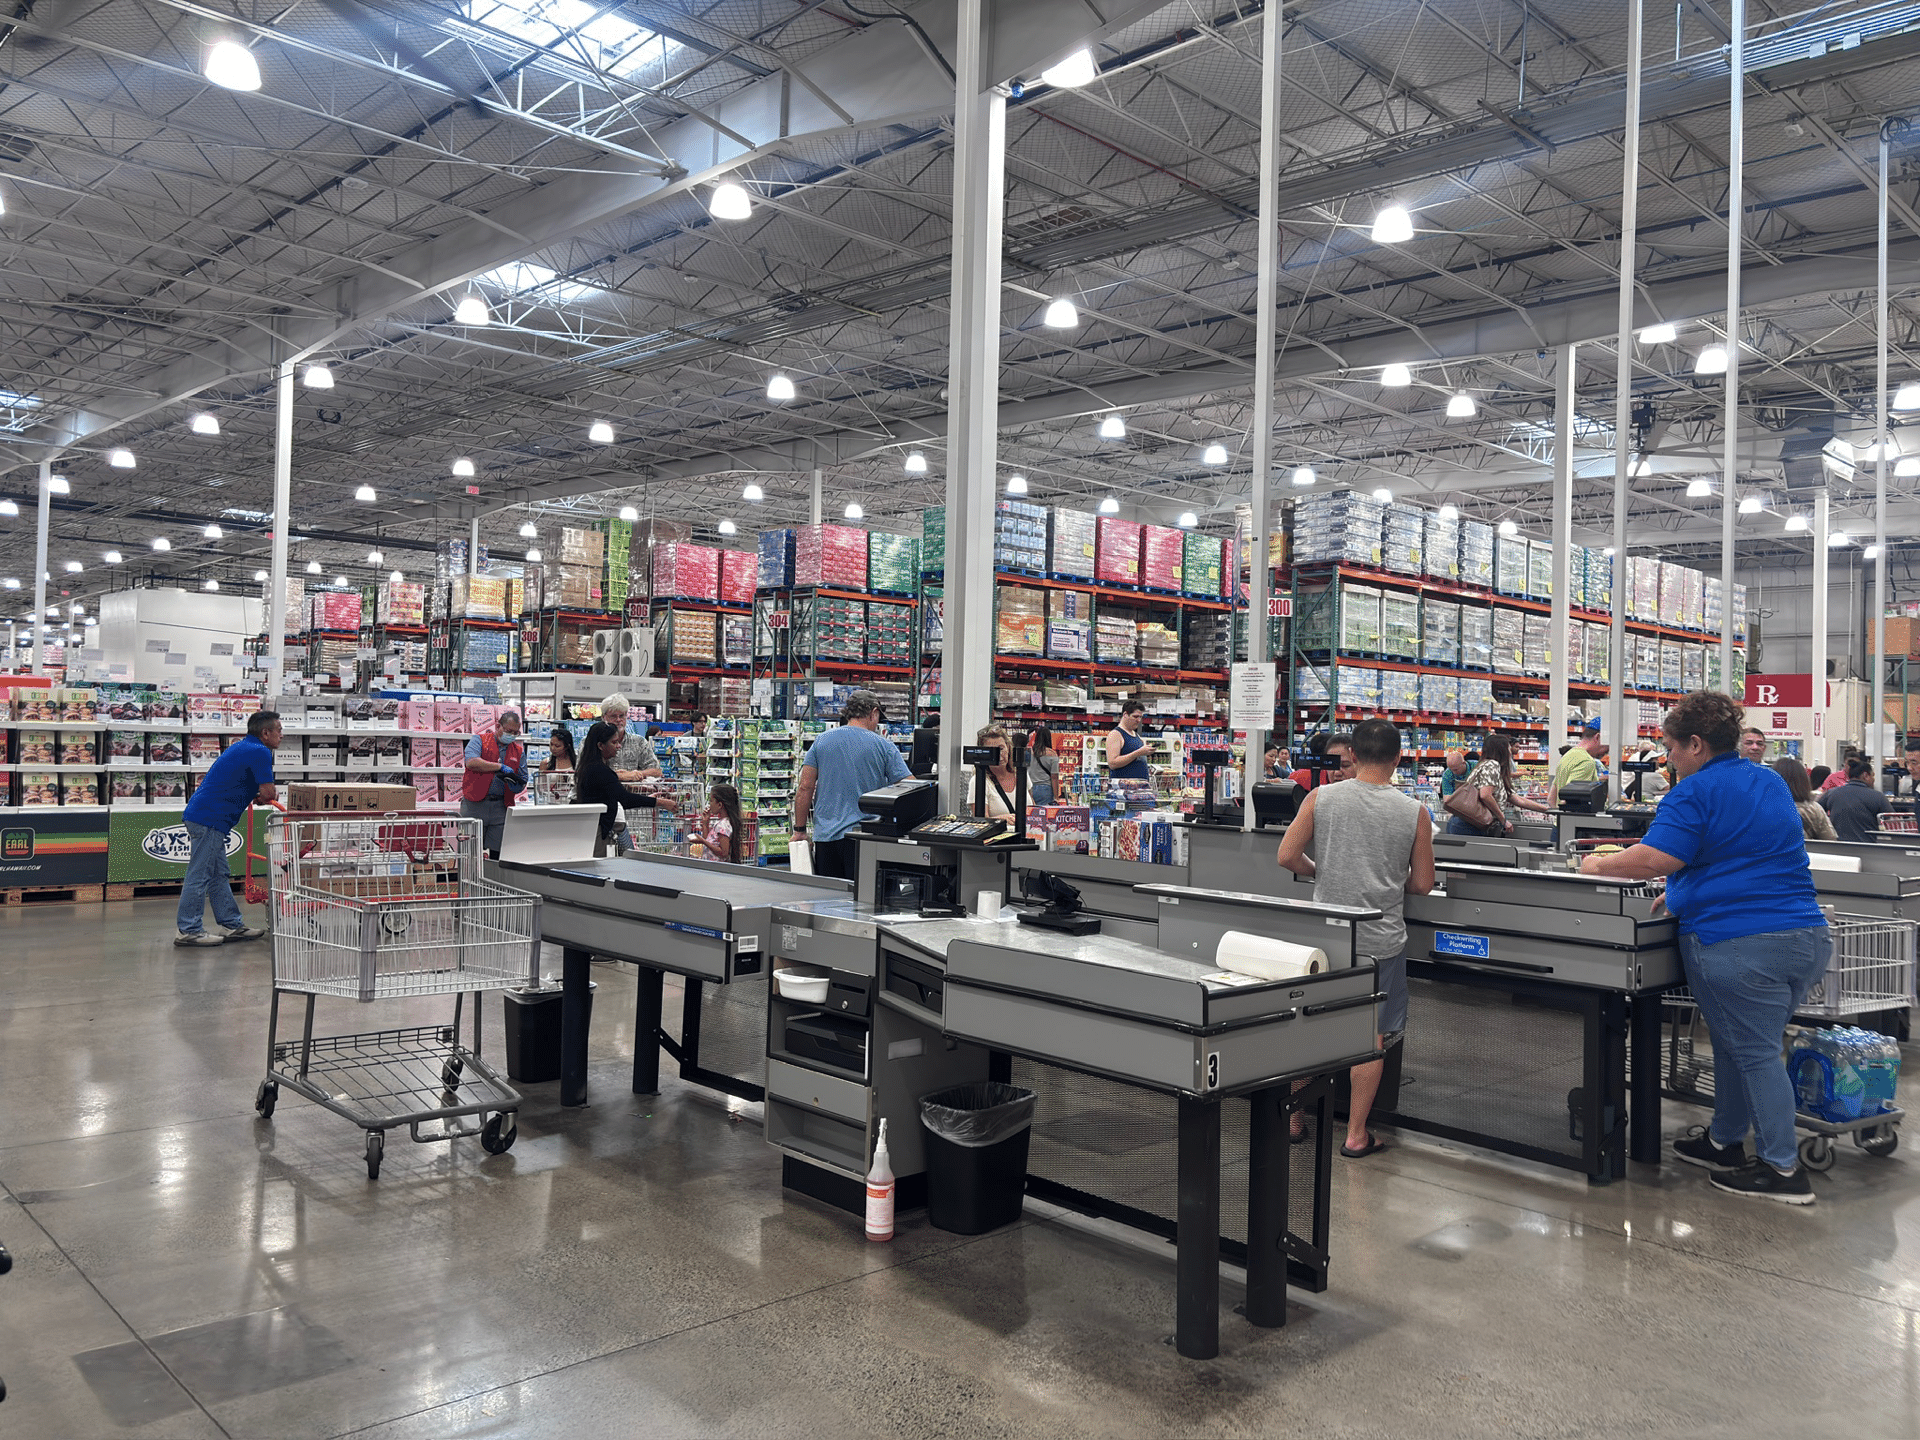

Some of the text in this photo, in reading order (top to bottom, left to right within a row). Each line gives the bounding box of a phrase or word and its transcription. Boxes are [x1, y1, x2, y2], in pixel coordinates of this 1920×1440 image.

[630, 604, 648, 617] 306
[1268, 599, 1290, 616] 300
[768, 614, 788, 628] 304
[521, 630, 538, 642] 308
[433, 638, 447, 648] 310
[348, 795, 353, 803] 6
[1055, 815, 1082, 823] KITCHEN
[1442, 933, 1482, 945] Checkwriting
[1448, 940, 1475, 950] Platform
[1636, 965, 1642, 987] 4
[1208, 1053, 1218, 1088] 3
